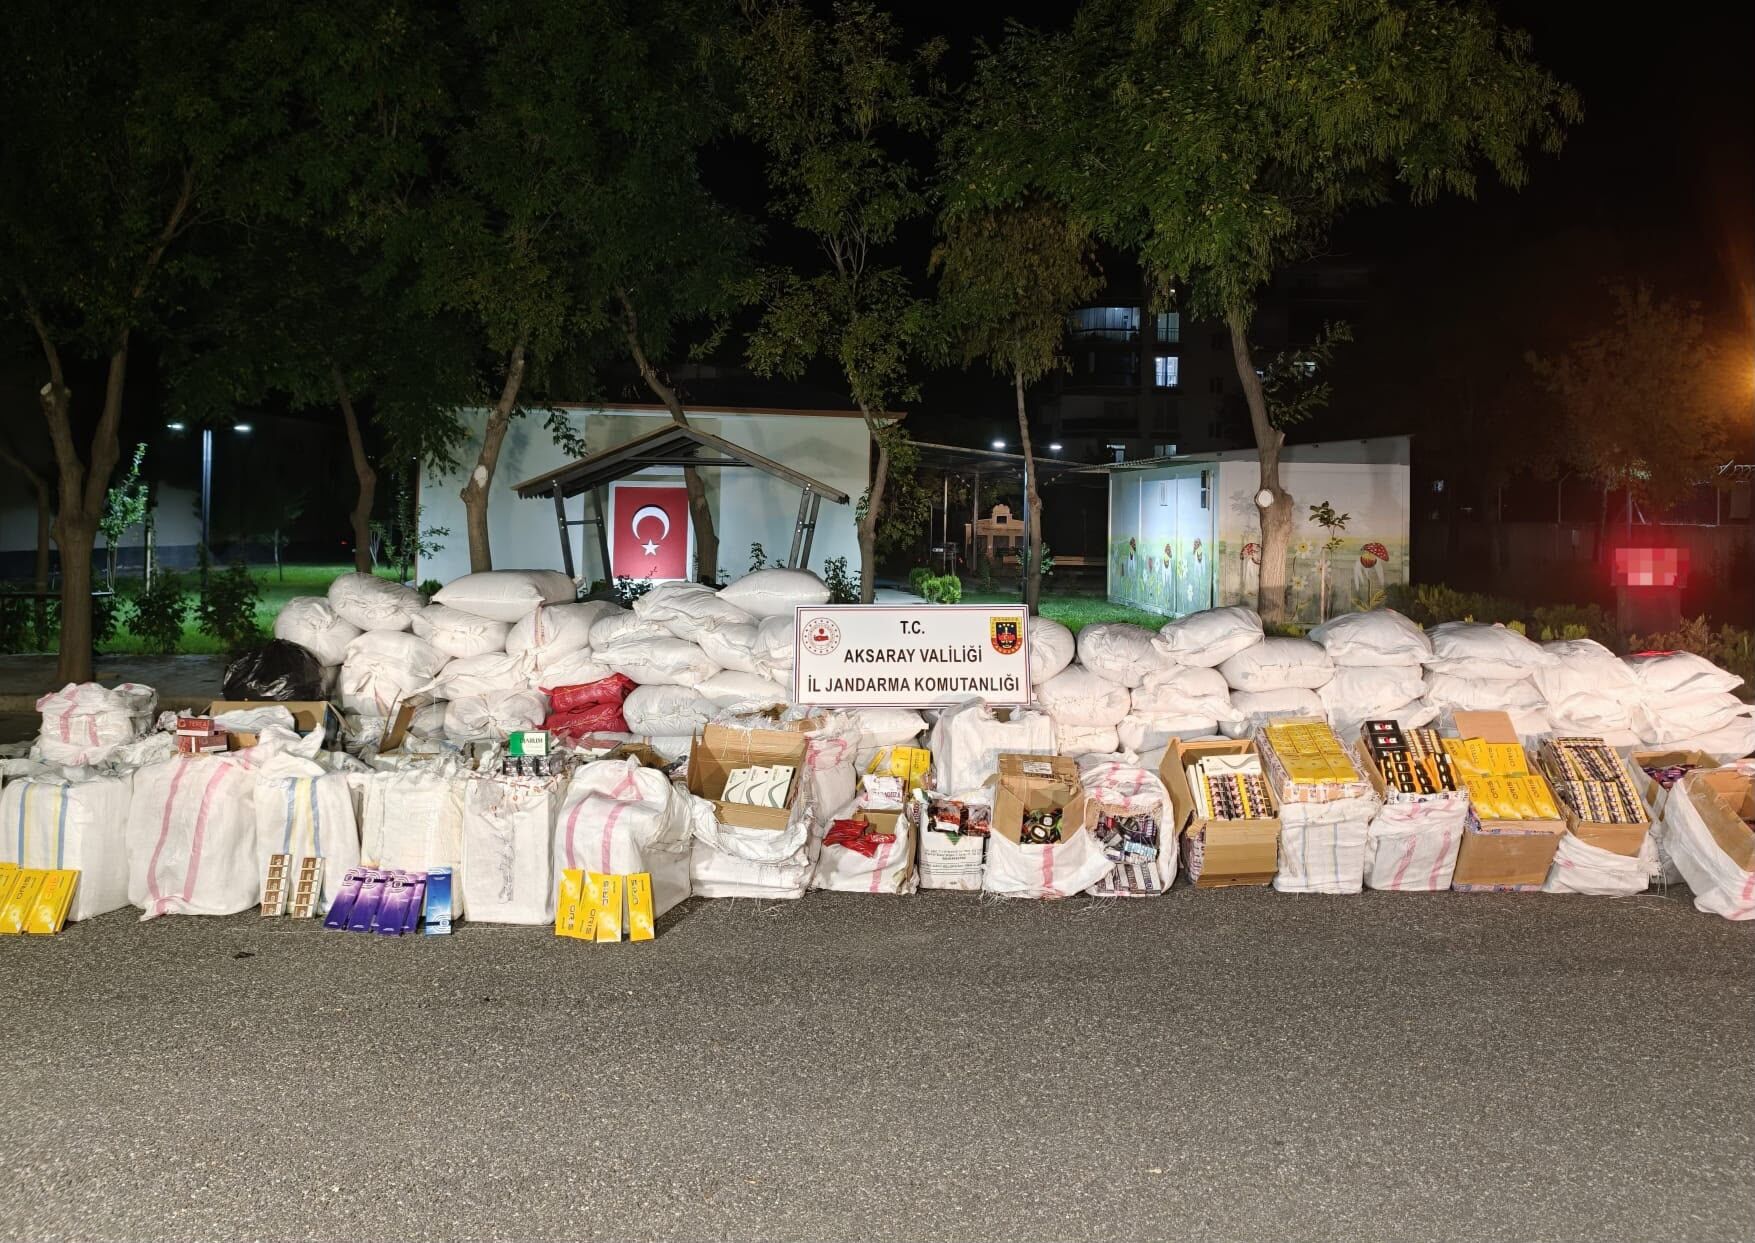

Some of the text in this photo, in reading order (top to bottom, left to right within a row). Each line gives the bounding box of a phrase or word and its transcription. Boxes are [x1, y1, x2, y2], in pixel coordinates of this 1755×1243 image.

[899, 620, 926, 635] T.C.
[843, 645, 983, 664] AKSARAY VALİLİĞİ
[807, 673, 1020, 692] İL JANDARMA KOMUTANLIĞI
